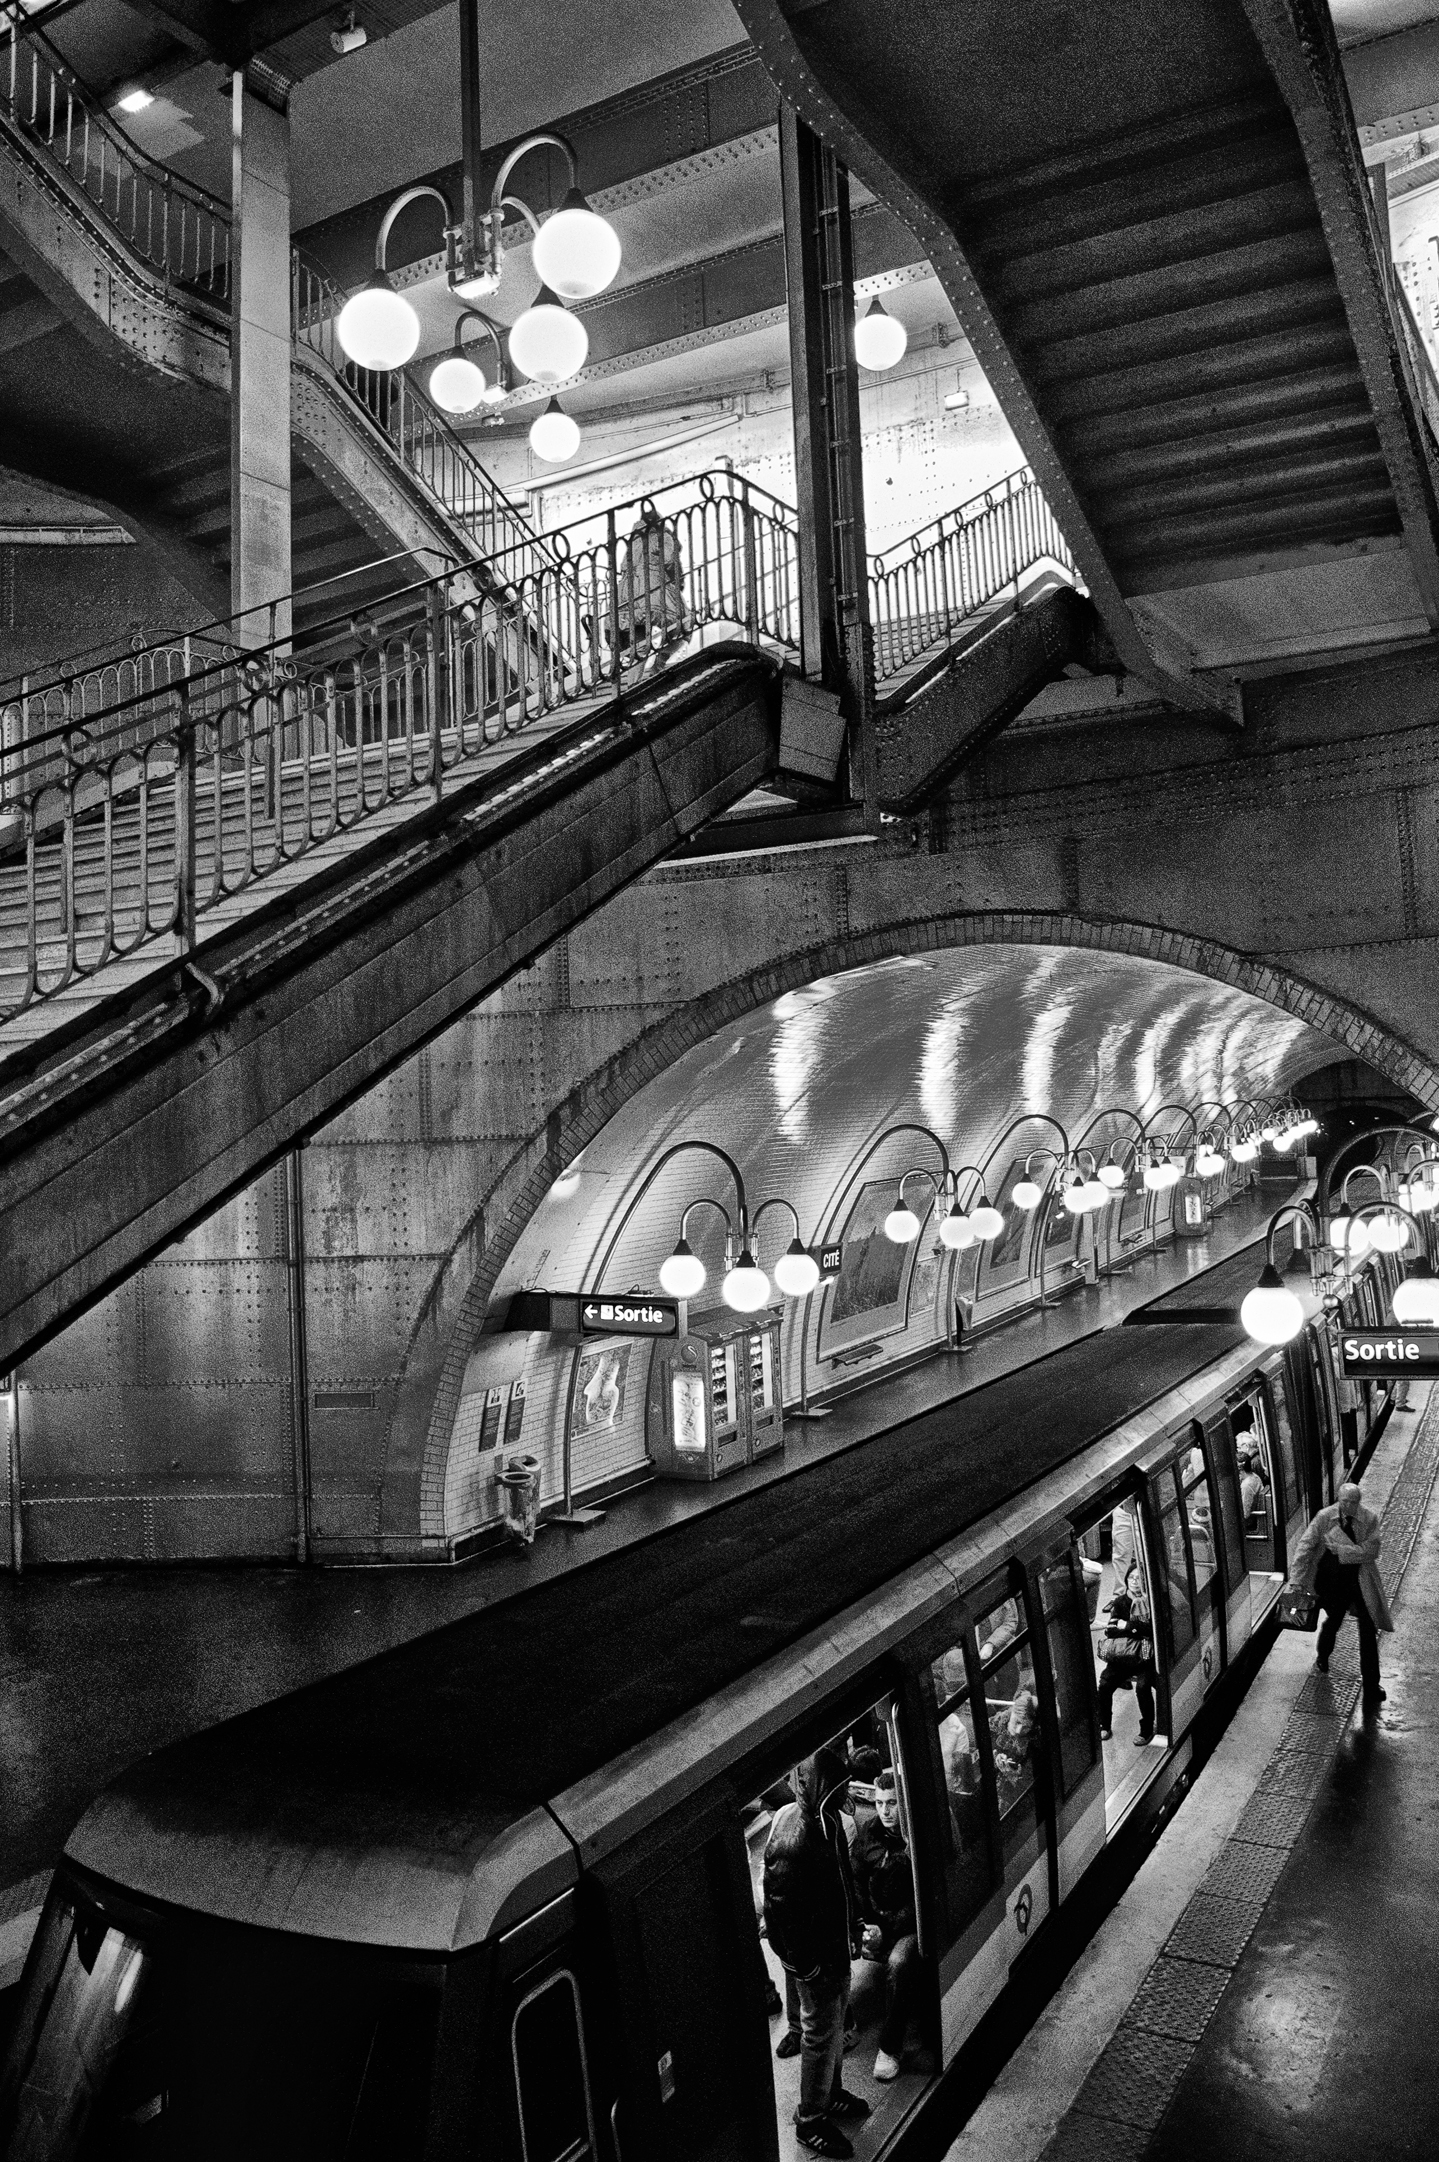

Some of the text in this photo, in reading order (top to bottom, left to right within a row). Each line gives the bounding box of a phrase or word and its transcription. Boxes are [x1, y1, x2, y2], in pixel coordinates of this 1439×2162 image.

[823, 1249, 840, 1268] CITÉ
[614, 1305, 663, 1323] Sortie
[1344, 1338, 1420, 1360] Sortie
